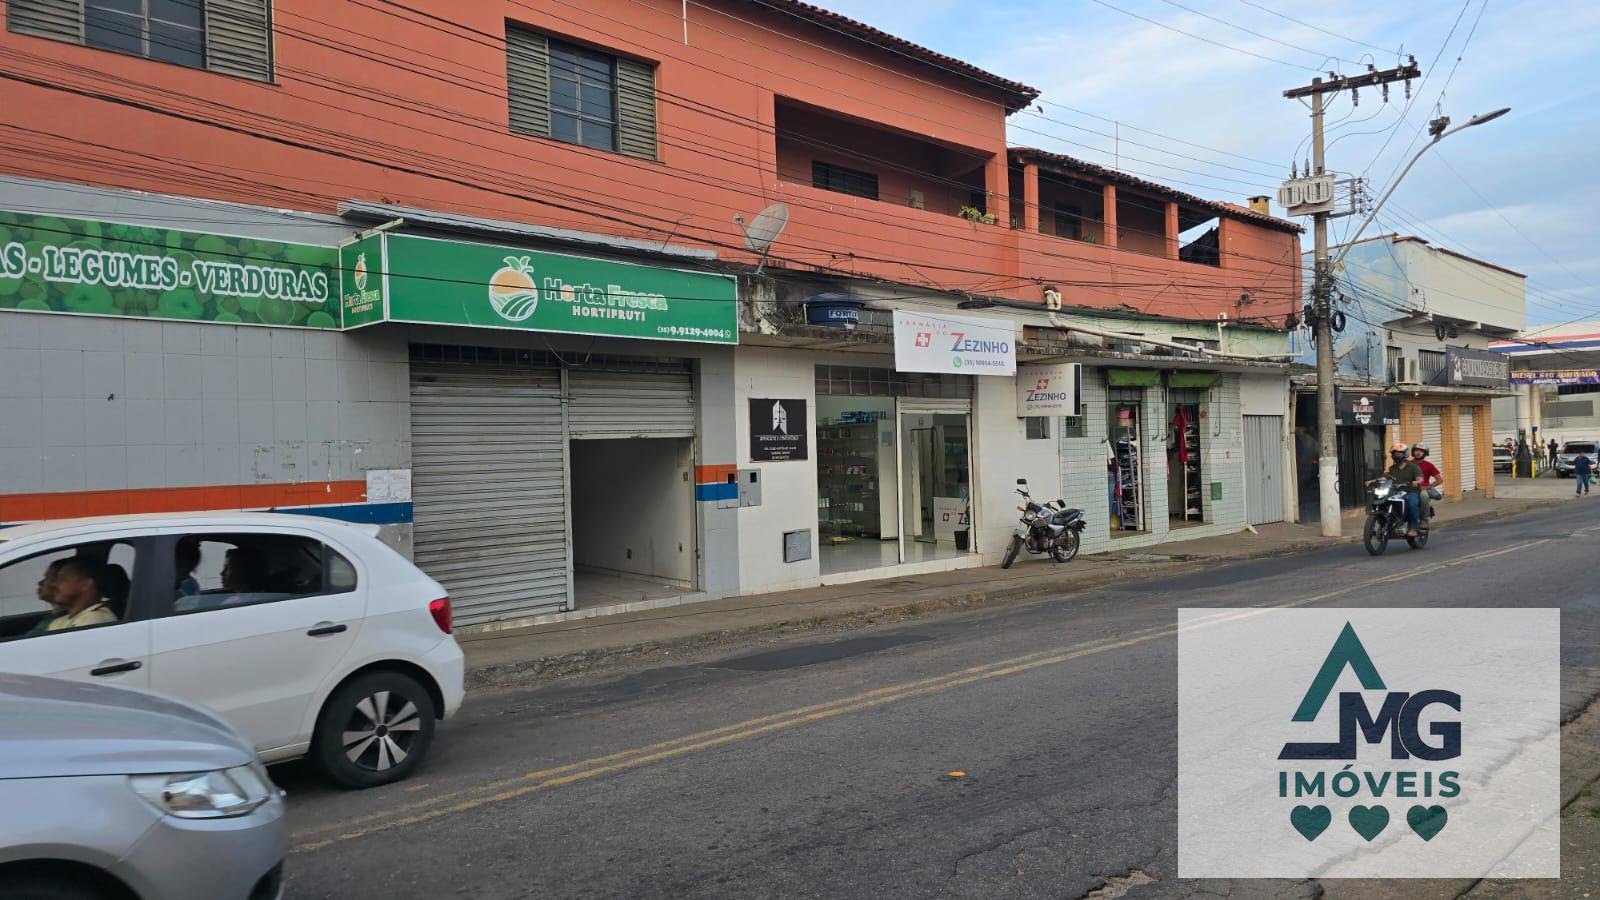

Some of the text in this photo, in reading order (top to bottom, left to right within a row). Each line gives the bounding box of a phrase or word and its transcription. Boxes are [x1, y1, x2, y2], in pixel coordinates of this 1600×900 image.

[42, 245, 178, 291] LEGUMES
[192, 260, 329, 303] VERDURAS
[543, 277, 606, 306] Horta
[572, 305, 646, 321] HORTIFRUTI
[670, 326, 724, 338] 9.9129-4004
[950, 332, 1009, 354] ZEZINHO
[1026, 389, 1067, 402] ZEZINHO
